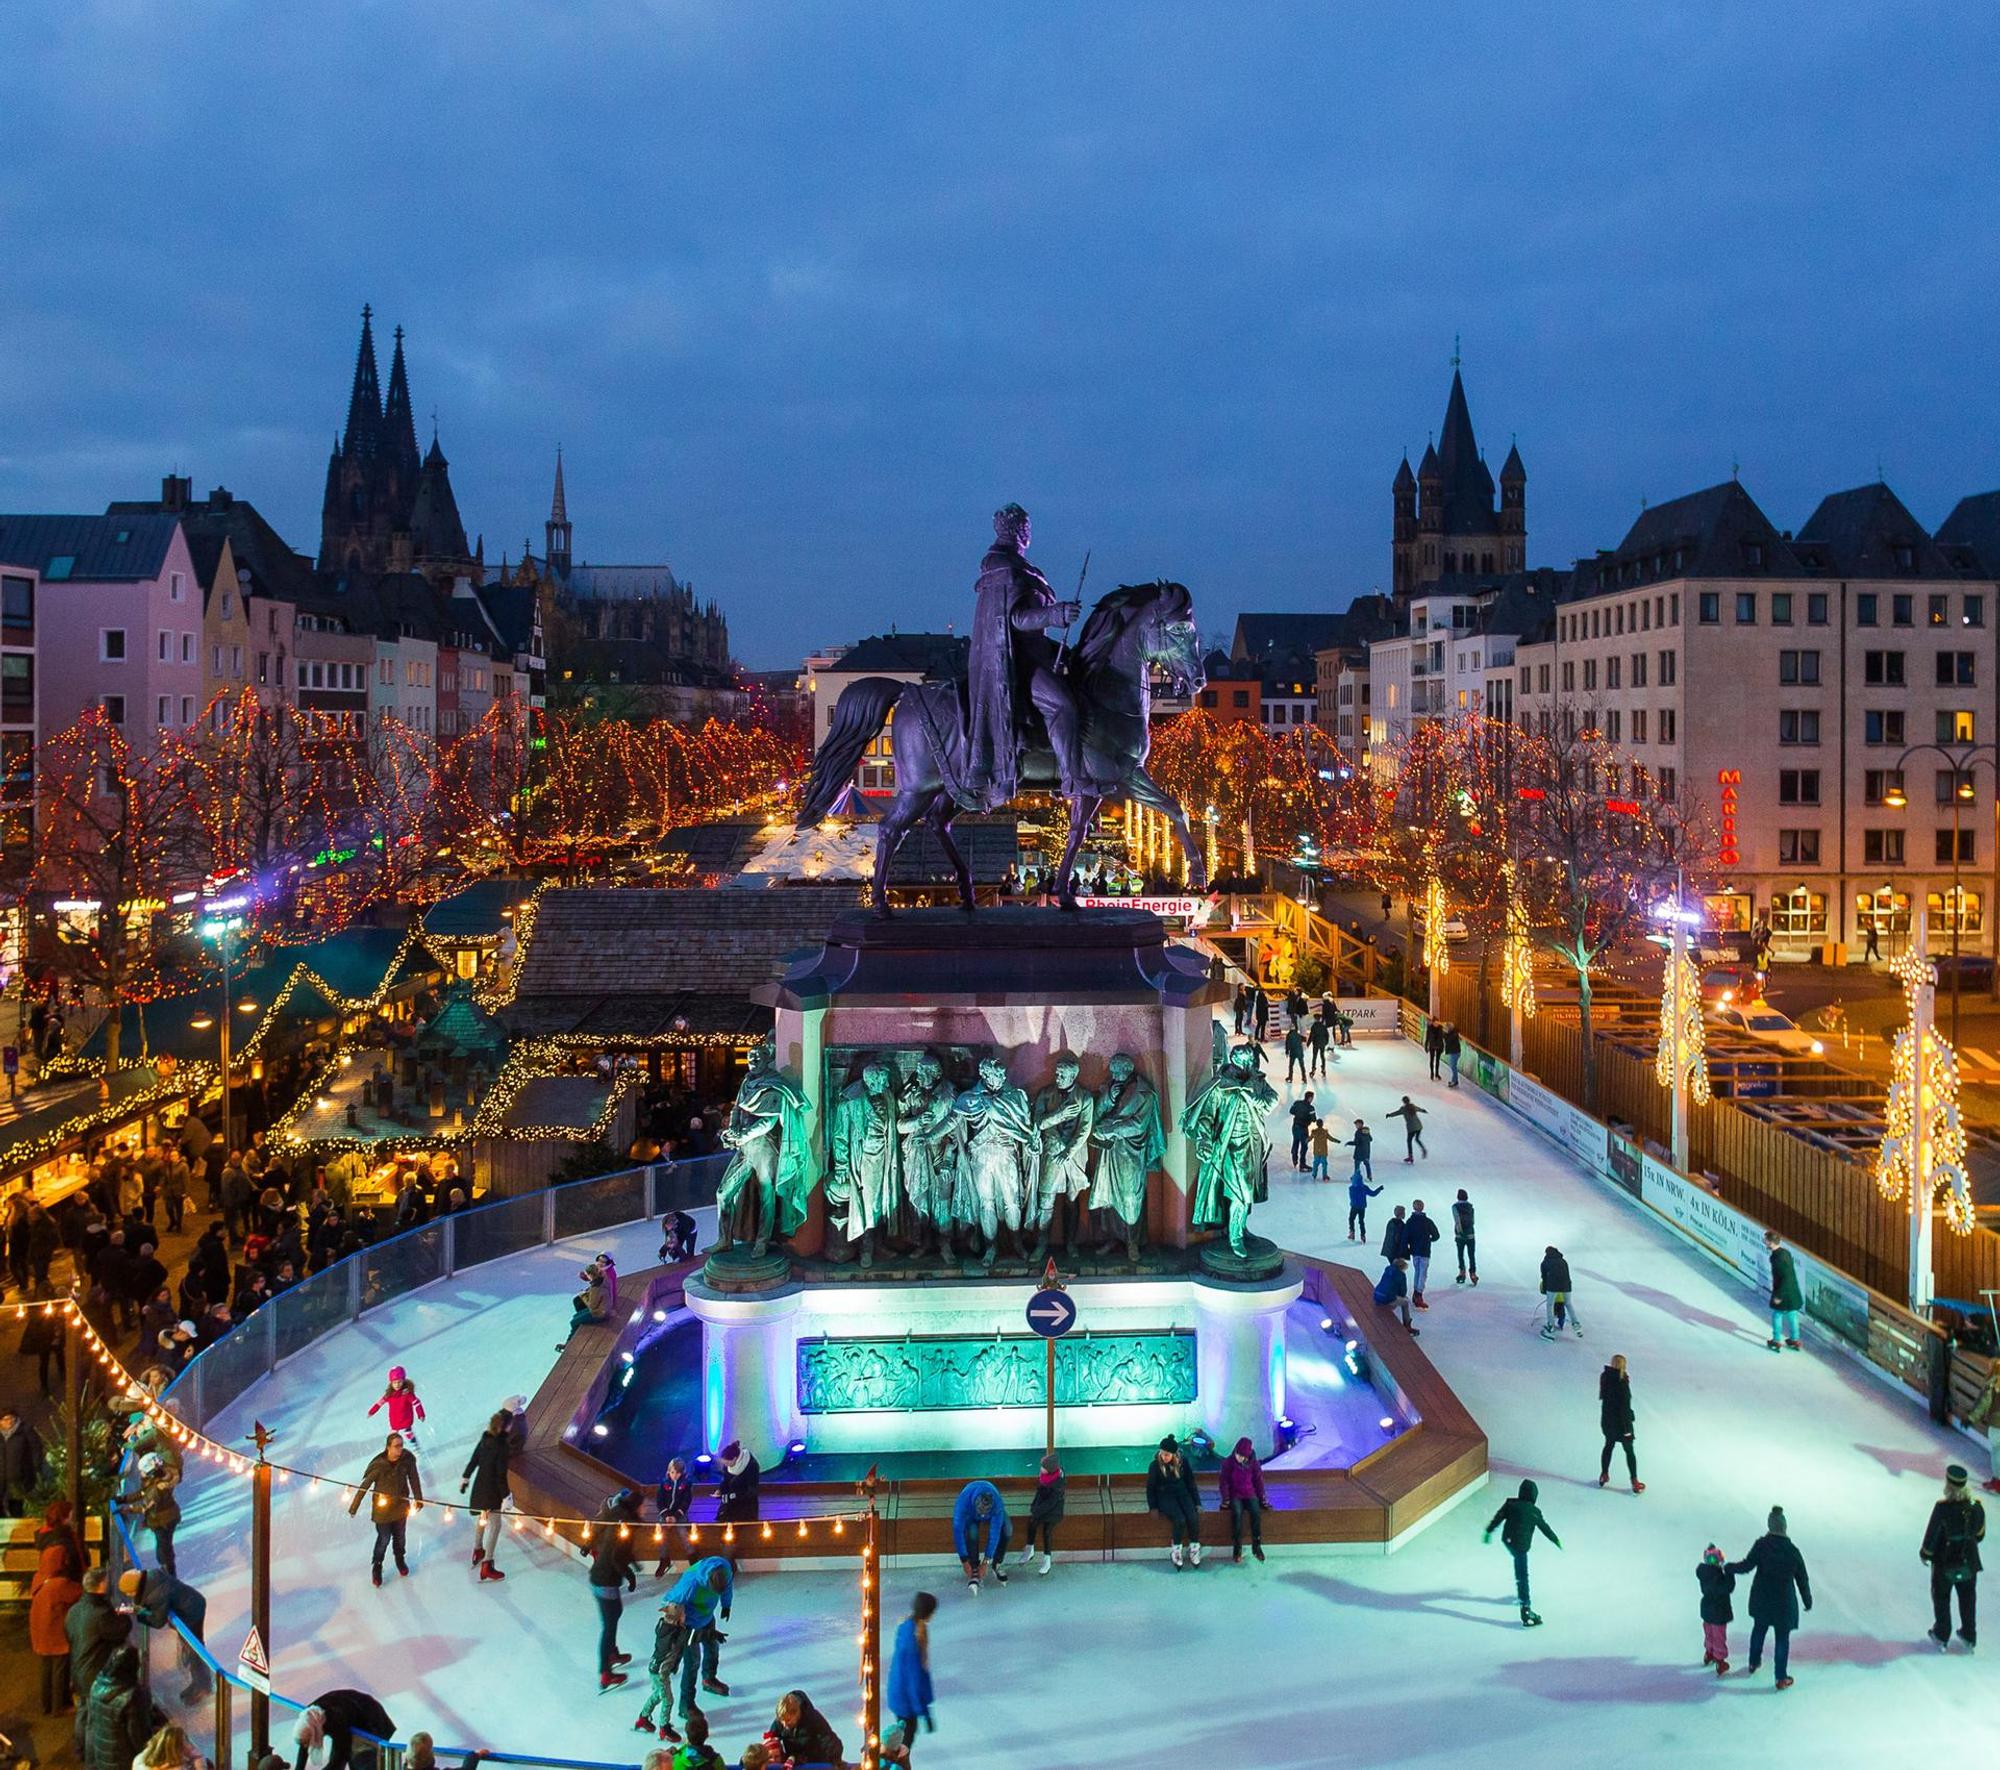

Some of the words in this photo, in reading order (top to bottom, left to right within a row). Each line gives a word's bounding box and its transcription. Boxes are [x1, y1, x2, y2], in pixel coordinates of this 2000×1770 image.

[1656, 1172, 1665, 1188] IN
[1690, 1196, 1700, 1212] 4x
[1701, 1201, 1711, 1218] IN
[1712, 1208, 1738, 1237] KÖLN.
